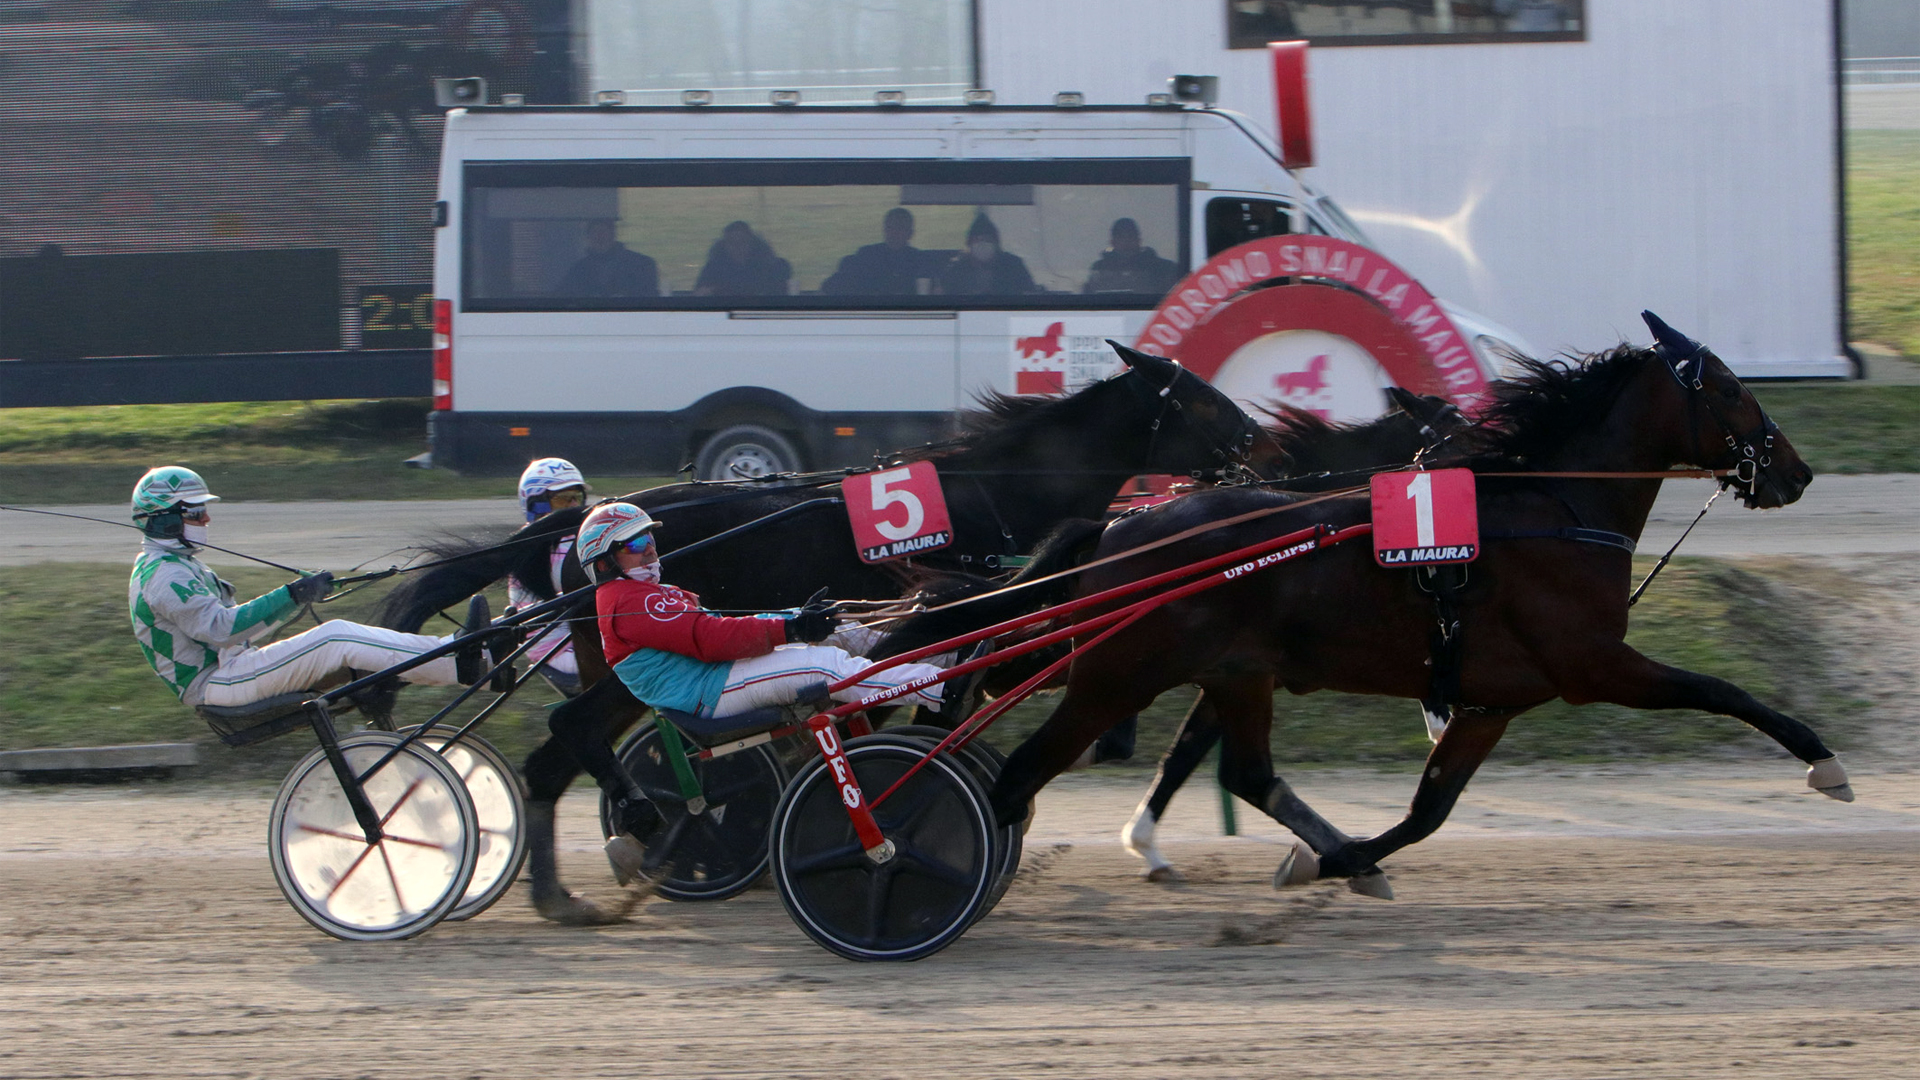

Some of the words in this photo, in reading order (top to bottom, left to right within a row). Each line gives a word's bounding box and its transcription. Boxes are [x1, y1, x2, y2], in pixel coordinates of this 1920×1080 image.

[1279, 244, 1366, 281] SNAI
[1364, 268, 1409, 309] LA
[870, 467, 925, 541] 5
[1406, 472, 1435, 547] 1
[869, 545, 889, 560] LA
[892, 533, 946, 555] MAURA
[1223, 561, 1255, 580] UFO
[1258, 540, 1317, 569] ECLIPSE
[1385, 549, 1407, 563] LA
[1411, 546, 1470, 562] MAURA
[169, 580, 210, 604] AG
[861, 683, 908, 705] Bareggio
[911, 673, 939, 688] Team
[815, 726, 861, 809] UFO
